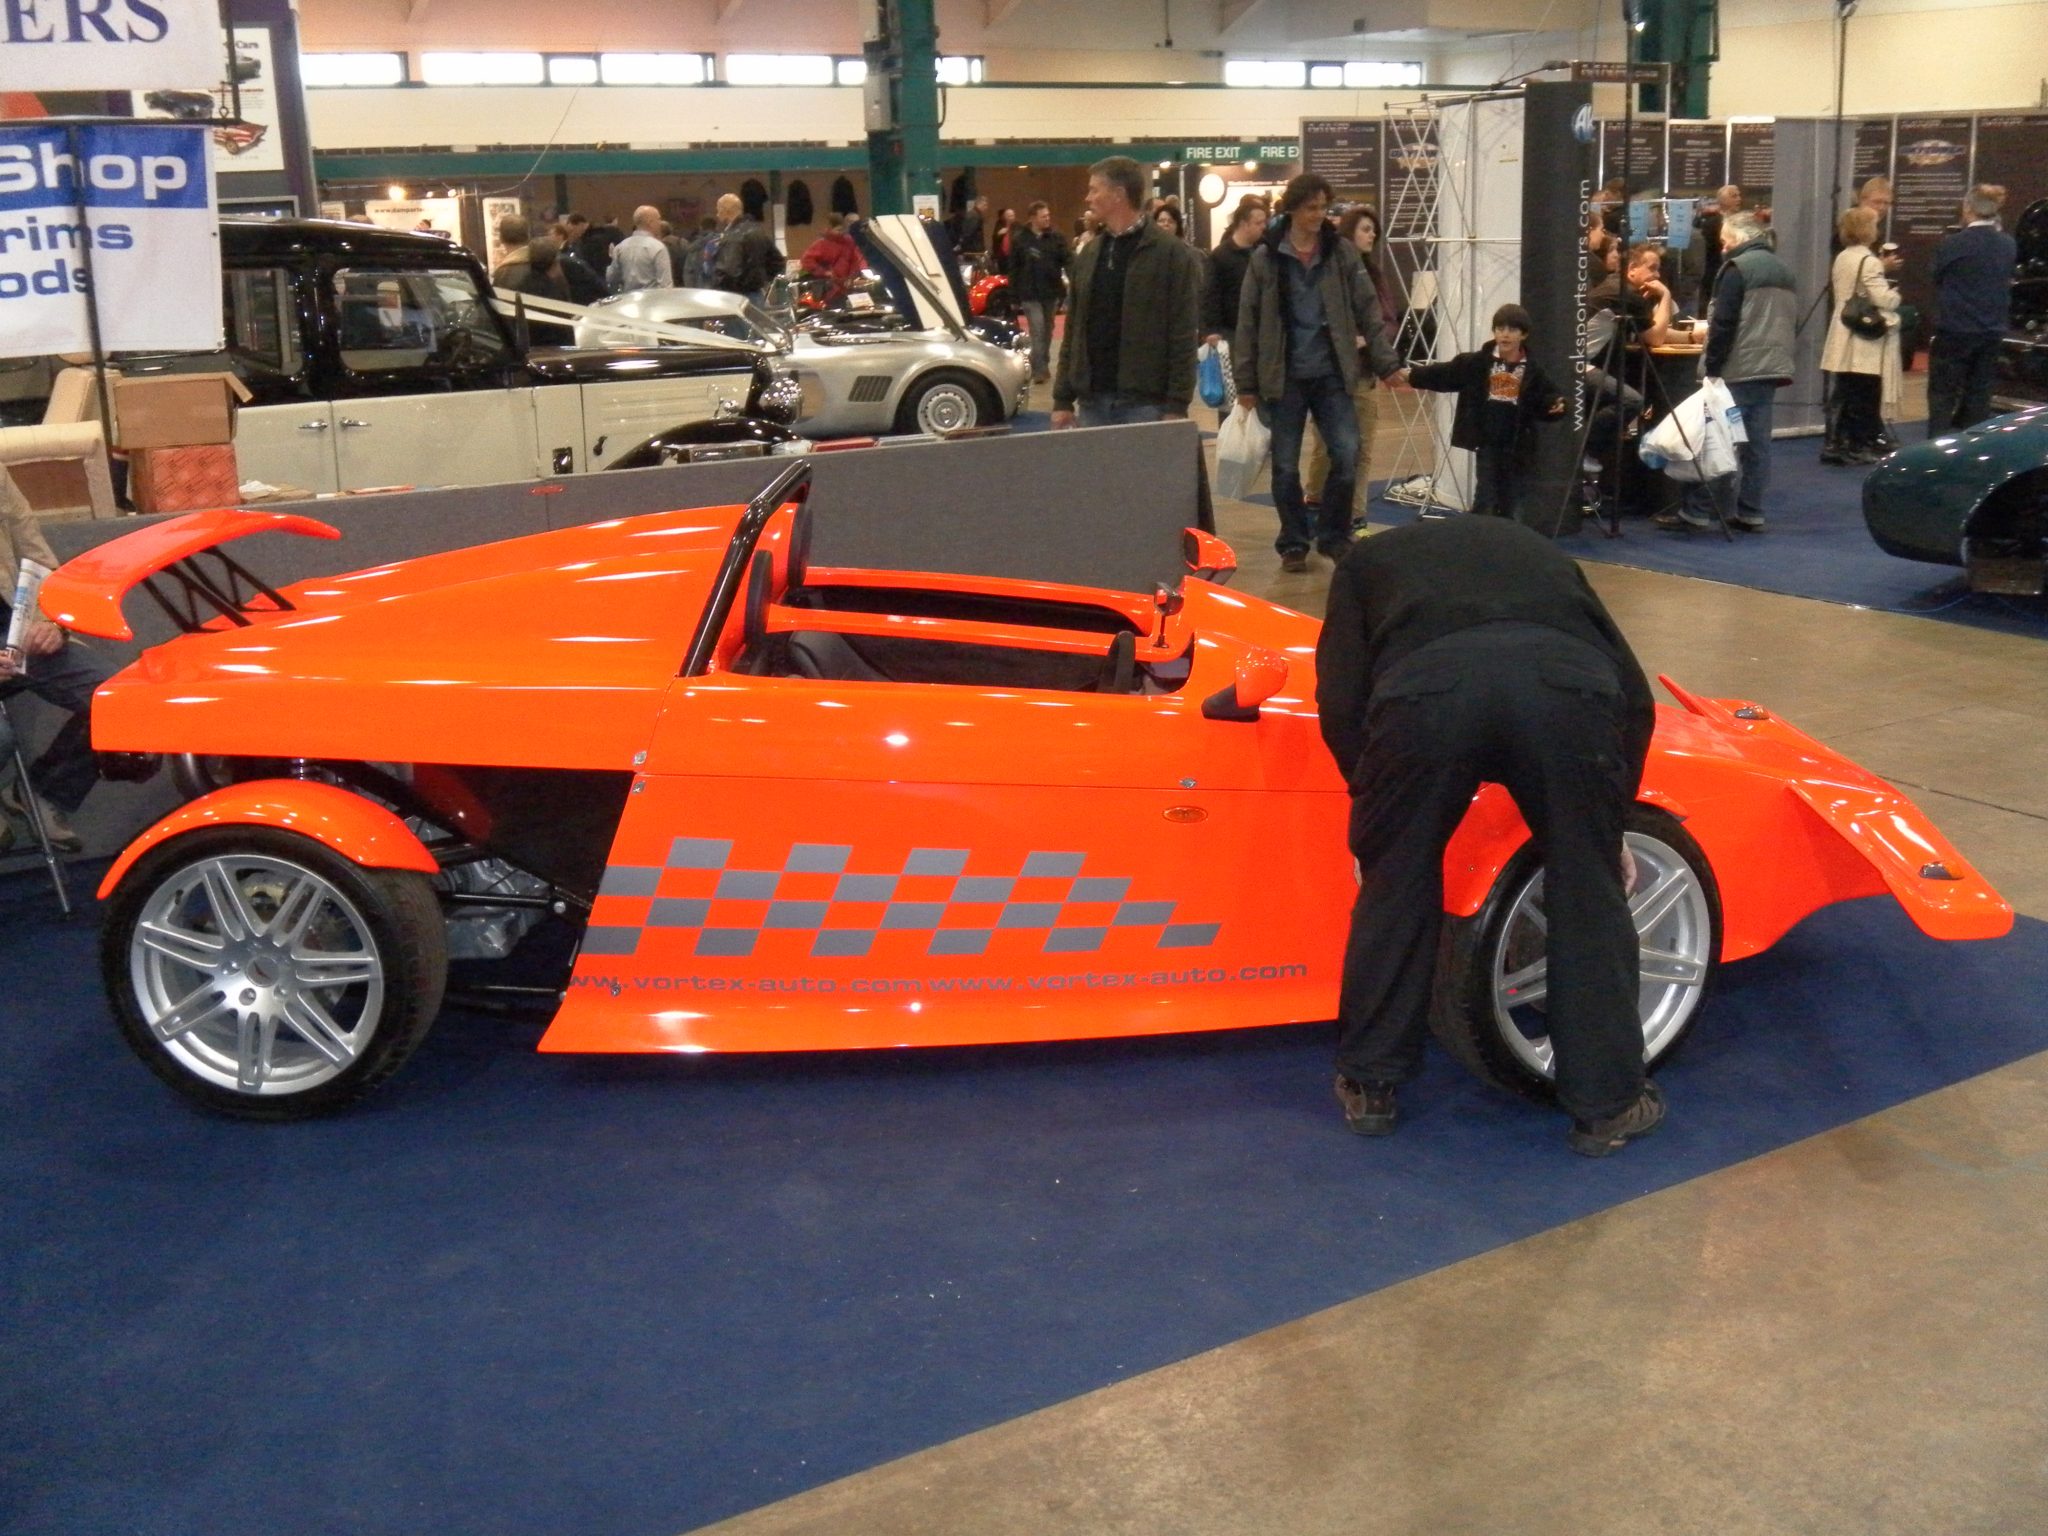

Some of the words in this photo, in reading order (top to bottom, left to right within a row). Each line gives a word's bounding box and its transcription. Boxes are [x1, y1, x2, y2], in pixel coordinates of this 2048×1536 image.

[1, 0, 169, 43] ERS
[1186, 147, 1213, 159] FIRE
[1215, 146, 1241, 159] EXIT
[1260, 146, 1286, 158] FIRE
[1568, 179, 1591, 431] www.aksportscars.com
[928, 963, 1307, 993] www.vortex-auto.com
